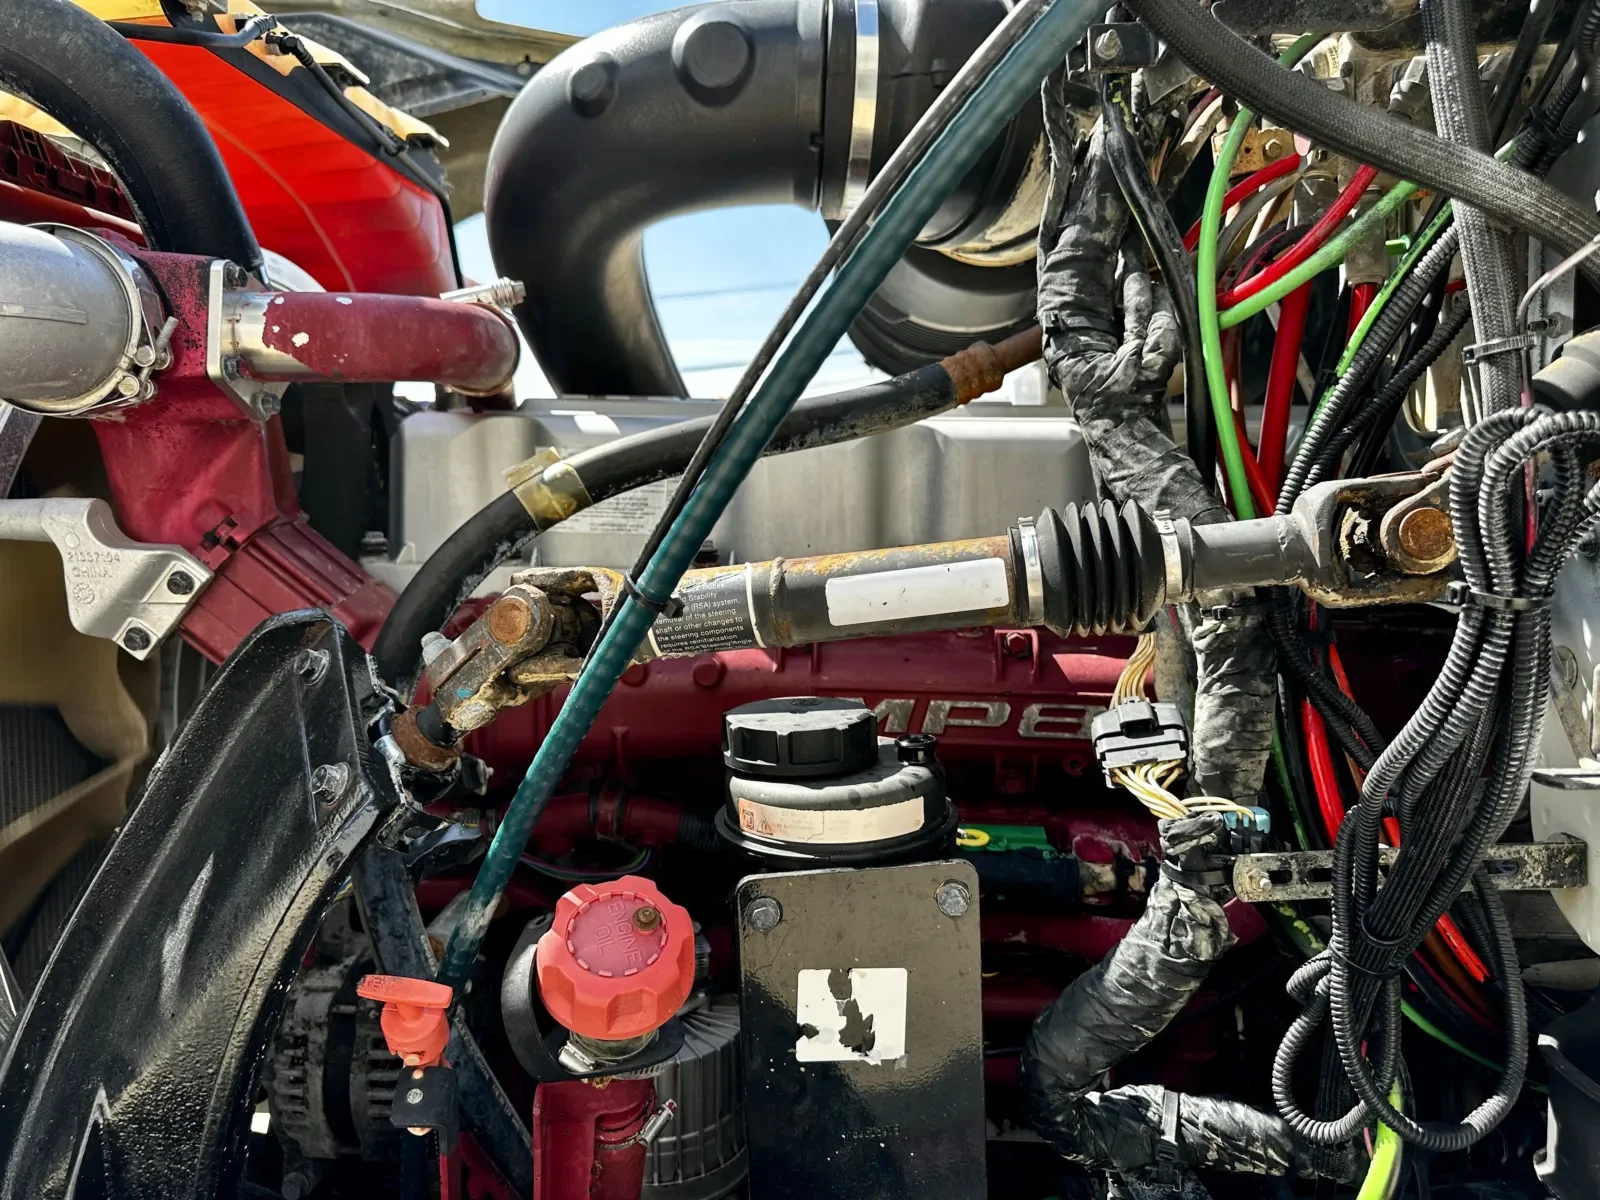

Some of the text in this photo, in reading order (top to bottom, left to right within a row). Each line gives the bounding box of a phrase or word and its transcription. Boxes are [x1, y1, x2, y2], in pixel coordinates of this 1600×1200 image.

[72, 565, 113, 578] CHINA
[689, 592, 717, 602] Stability
[691, 600, 711, 611] (RSA)
[686, 613, 693, 621] of
[694, 611, 706, 620] the
[707, 608, 737, 618] steering
[655, 625, 673, 635] shaft
[683, 622, 702, 630] other
[704, 617, 734, 628] changes
[670, 631, 699, 641] steering
[700, 625, 744, 636] components
[660, 634, 738, 649] requires reinitialization
[608, 900, 643, 966] ENGINE
[594, 926, 614, 956] OIL
